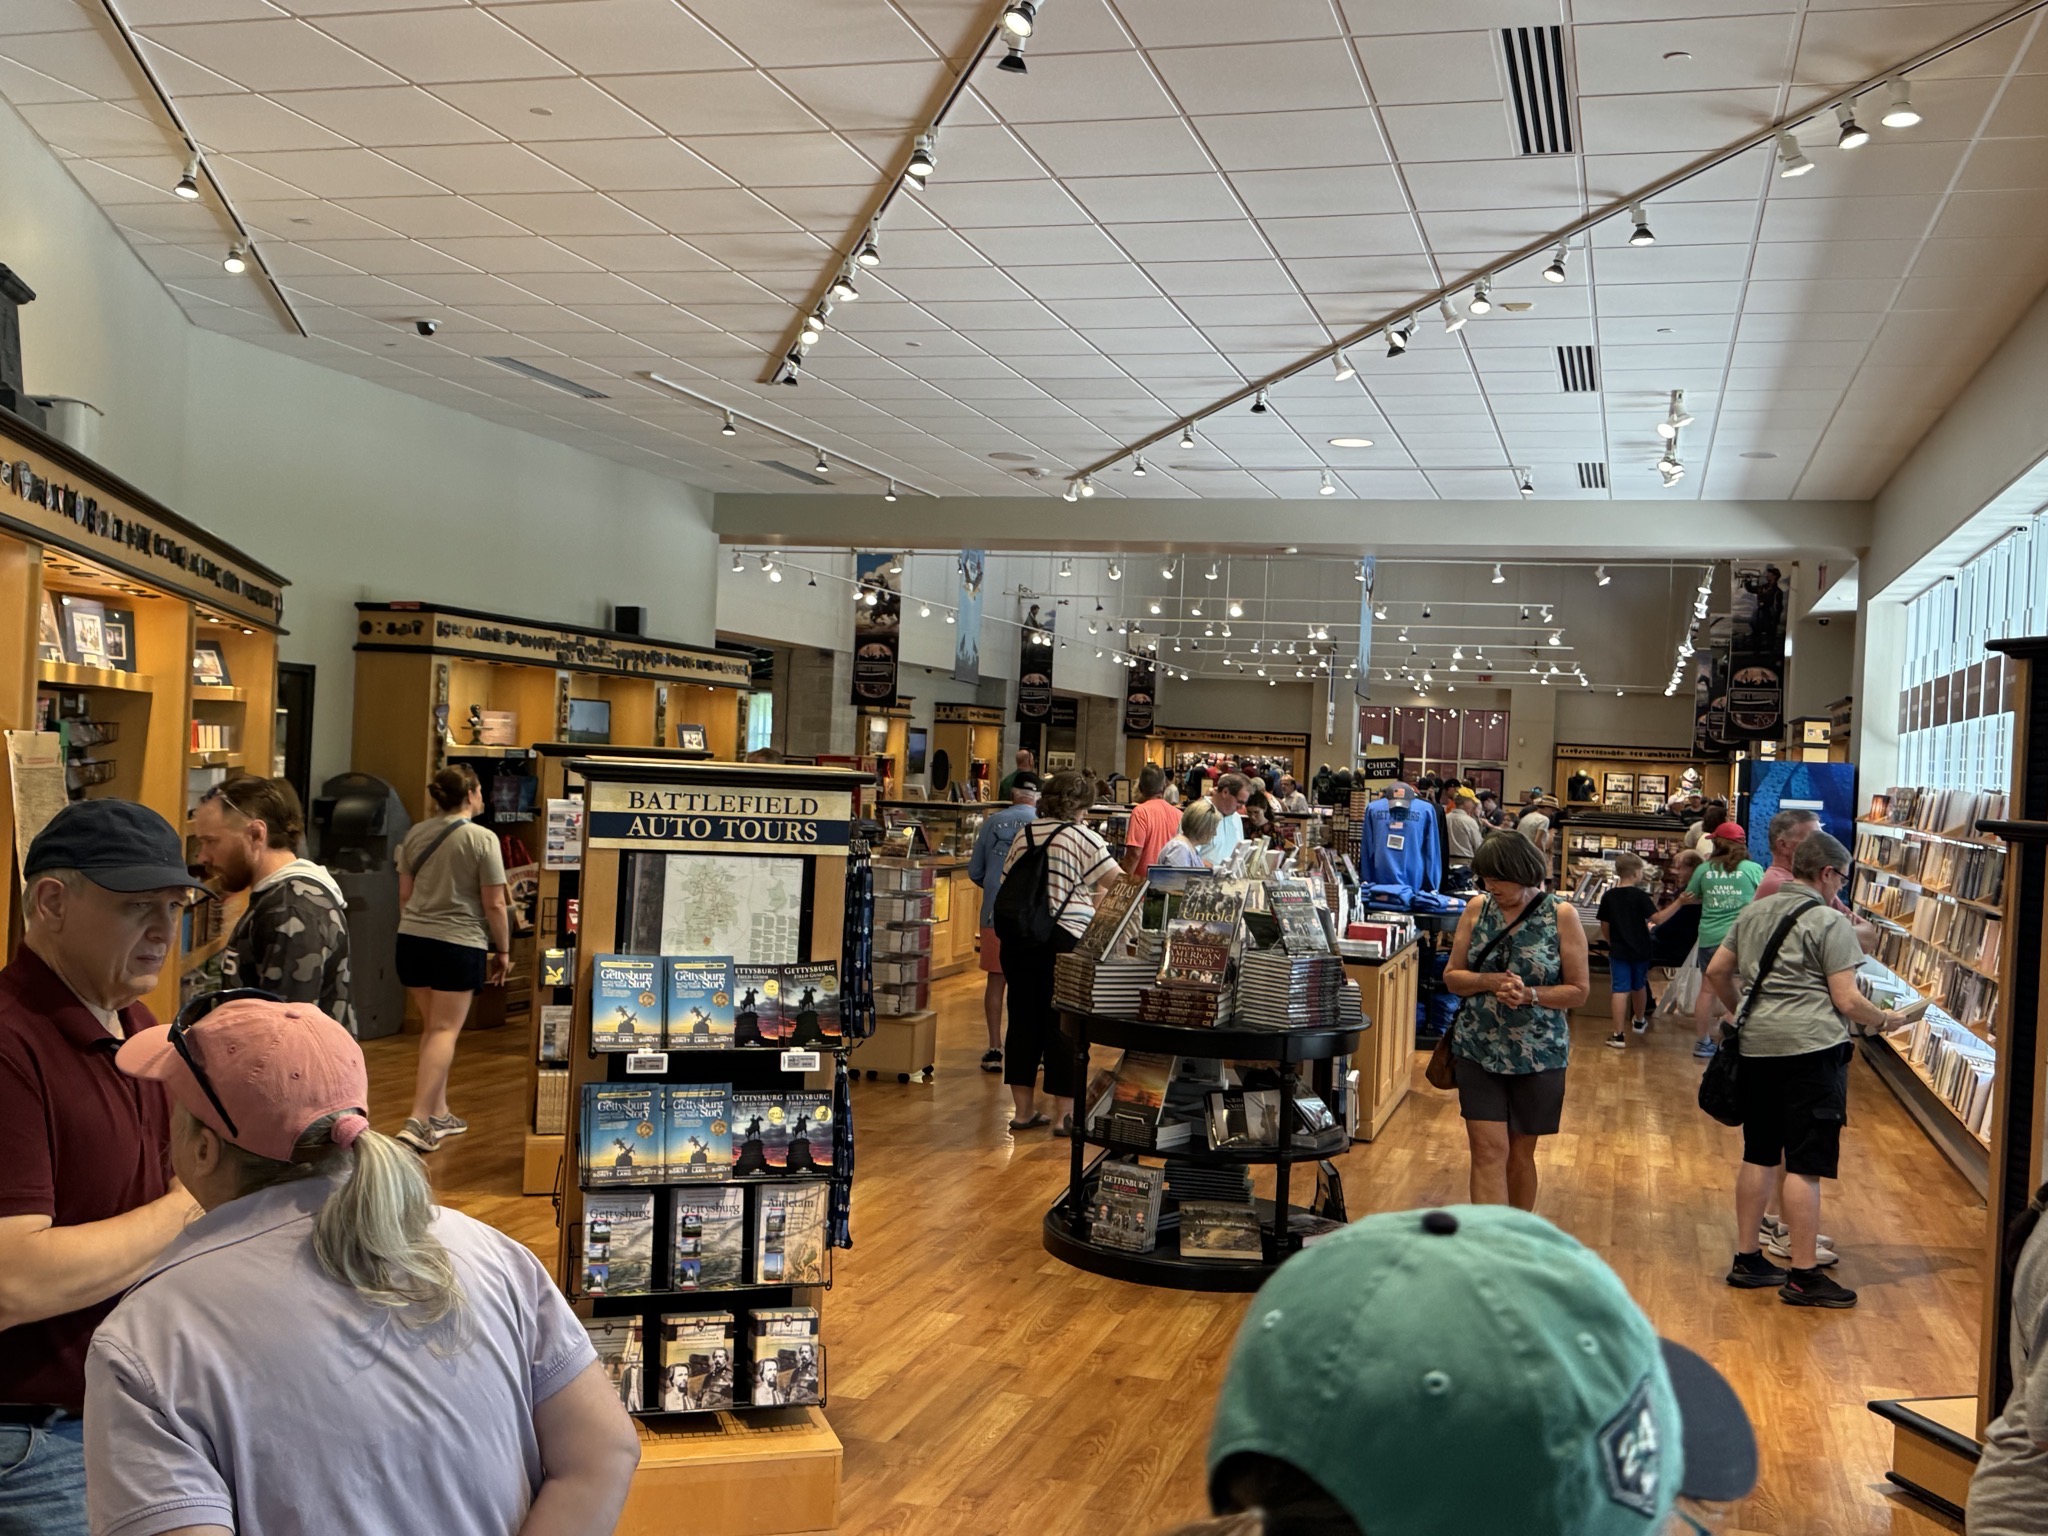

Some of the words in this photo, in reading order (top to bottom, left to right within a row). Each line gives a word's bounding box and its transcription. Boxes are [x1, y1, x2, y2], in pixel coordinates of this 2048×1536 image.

[628, 791, 819, 816] BATTLEFIELD
[626, 816, 712, 839] AUTO
[719, 818, 818, 842] TOURS
[1706, 870, 1743, 879] STAFF
[1111, 883, 1137, 898] ATLAS
[1182, 907, 1236, 923] Untold
[1171, 949, 1221, 961] AMERICAN
[1171, 956, 1216, 967] HISTORY
[735, 967, 778, 975] ETTYSBURG
[784, 964, 835, 976] GETTYSBURG
[601, 970, 653, 983] Gettysburg
[674, 970, 726, 984] Gettysburg
[628, 979, 653, 991] Story
[702, 980, 726, 991] Story
[732, 1094, 783, 1102] GETTYSBURG
[597, 1100, 650, 1113] Gettysburg
[672, 1099, 723, 1112] Gettysburg
[625, 1108, 650, 1120] Story
[700, 1107, 724, 1119] Story
[1103, 1175, 1149, 1190] GETTYSBURG
[767, 1197, 814, 1208] Antietam
[590, 1207, 651, 1222] Gettysburg
[680, 1202, 740, 1216] Gettysburg
